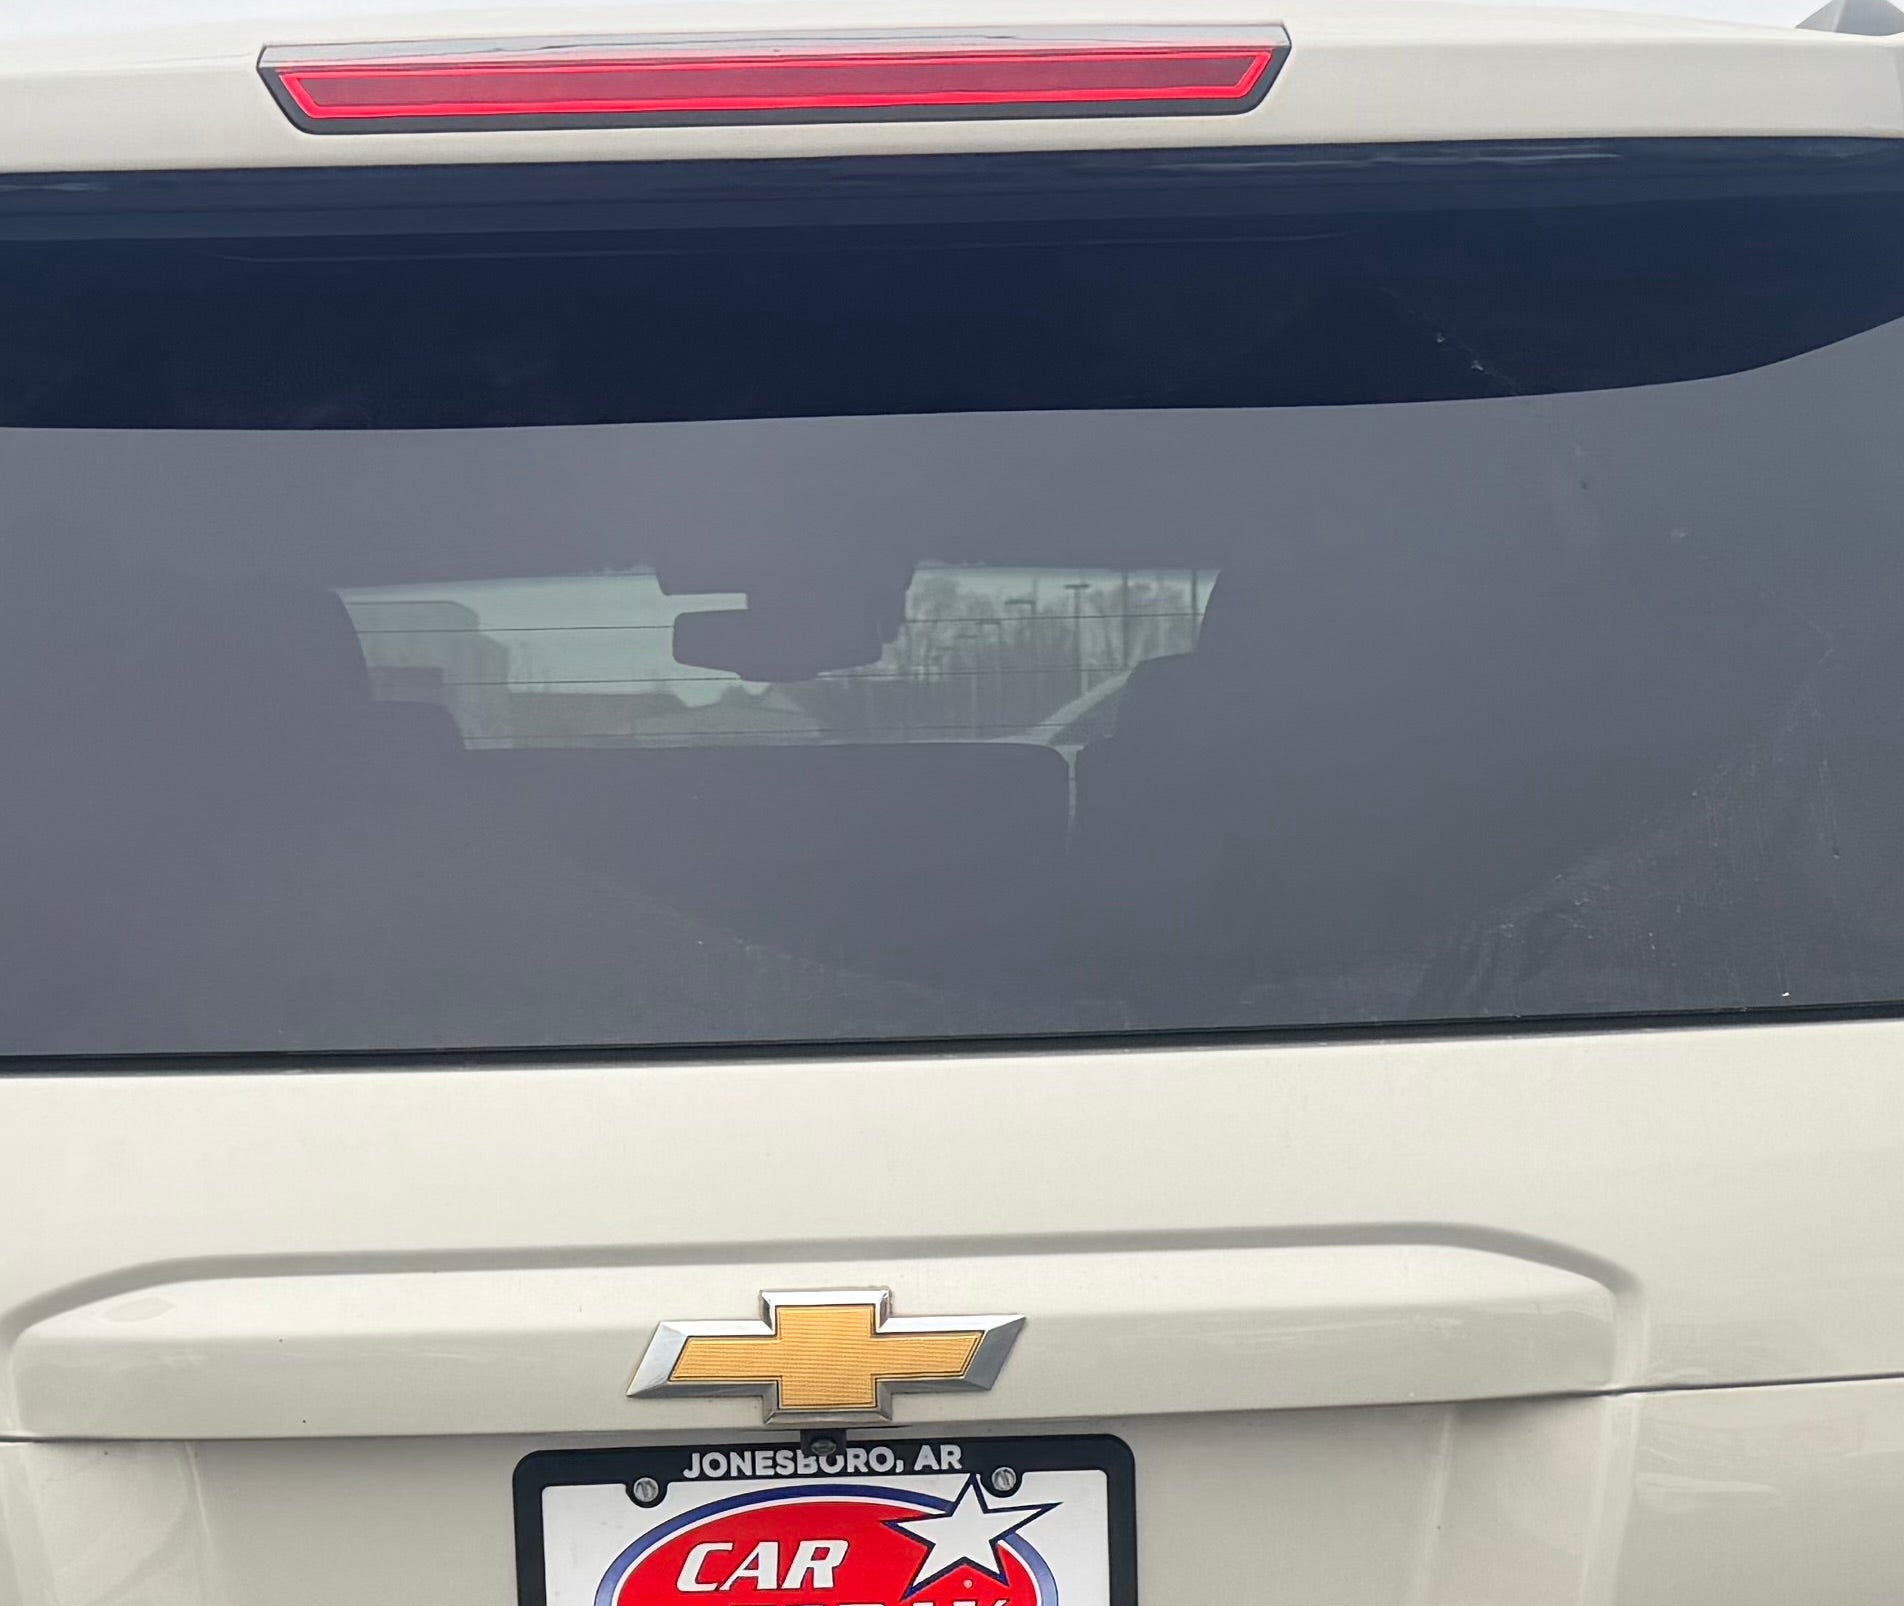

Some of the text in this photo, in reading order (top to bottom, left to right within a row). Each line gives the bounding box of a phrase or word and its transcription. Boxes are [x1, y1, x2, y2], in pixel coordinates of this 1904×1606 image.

[682, 1444, 963, 1479] JONESBORO, AR
[675, 1539, 850, 1593] CAR
